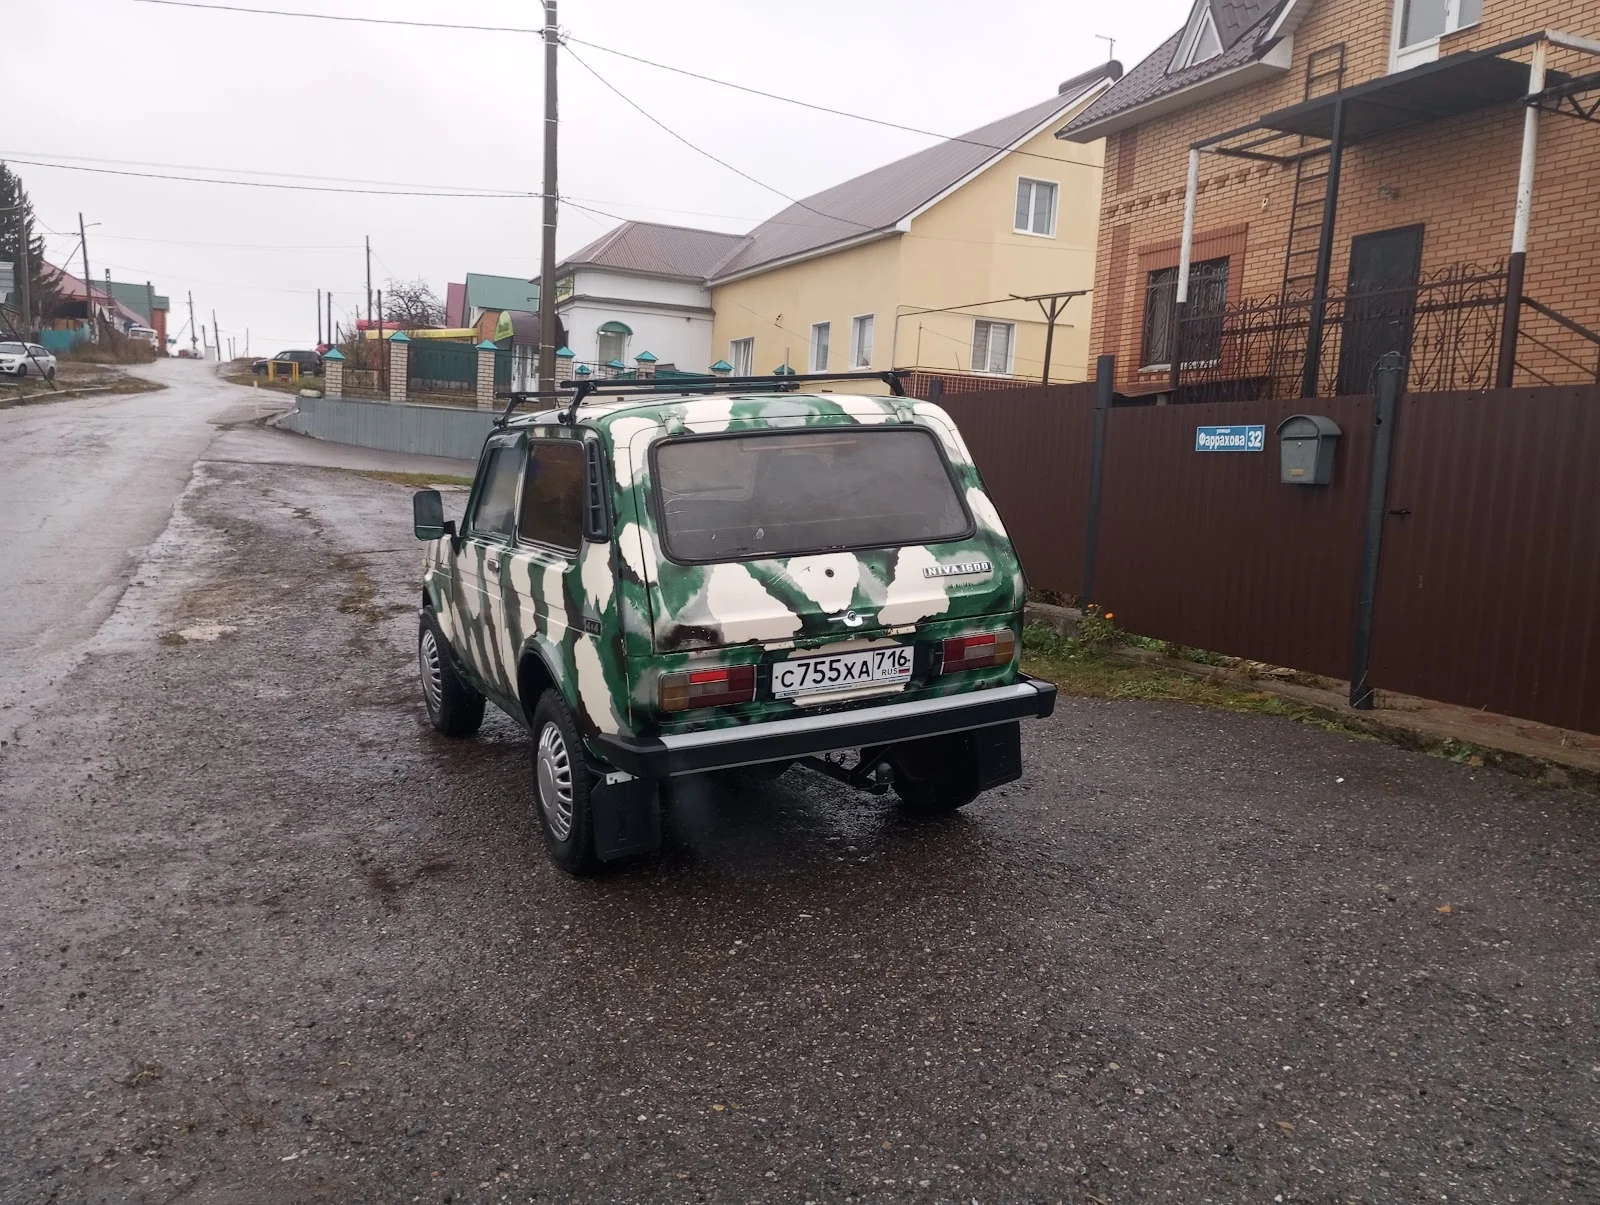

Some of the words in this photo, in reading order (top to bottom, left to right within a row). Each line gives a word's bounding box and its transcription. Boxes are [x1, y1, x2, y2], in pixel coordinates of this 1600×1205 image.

[1199, 432, 1245, 449] Фаррахова
[1248, 430, 1262, 447] 32
[928, 566, 958, 575] NIVA
[960, 562, 989, 572] 1600
[875, 649, 908, 670] 716
[881, 667, 898, 676] RUS
